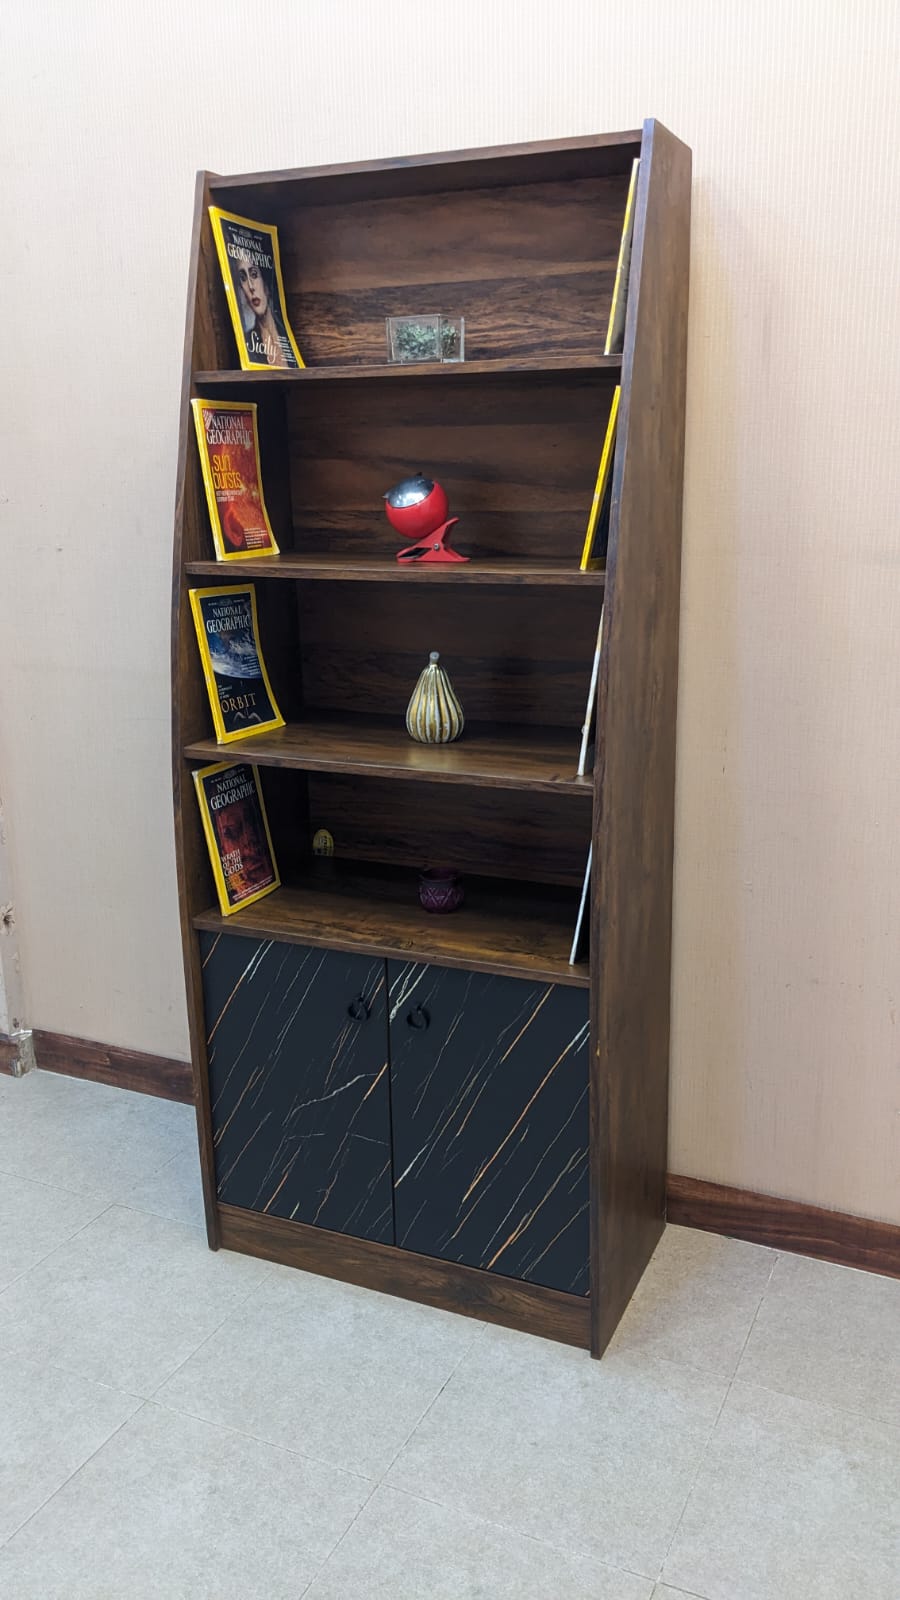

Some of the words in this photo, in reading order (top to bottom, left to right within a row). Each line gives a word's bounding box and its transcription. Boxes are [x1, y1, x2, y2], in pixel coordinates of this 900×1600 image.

[232, 233, 263, 252] NATIONAL
[227, 243, 272, 269] GEOGRAPHIC
[246, 331, 277, 364] Sicily
[211, 415, 244, 430] NATIONAL
[206, 429, 252, 445] GEOGRAPHIC
[212, 605, 242, 618] NATIONAL
[206, 615, 252, 633] GEOGRAPHIC
[221, 693, 256, 713] ORBIT
[217, 774, 247, 793] NATIONAL
[210, 782, 256, 810] GEOGRAPHIC
[224, 863, 244, 877] GODS
